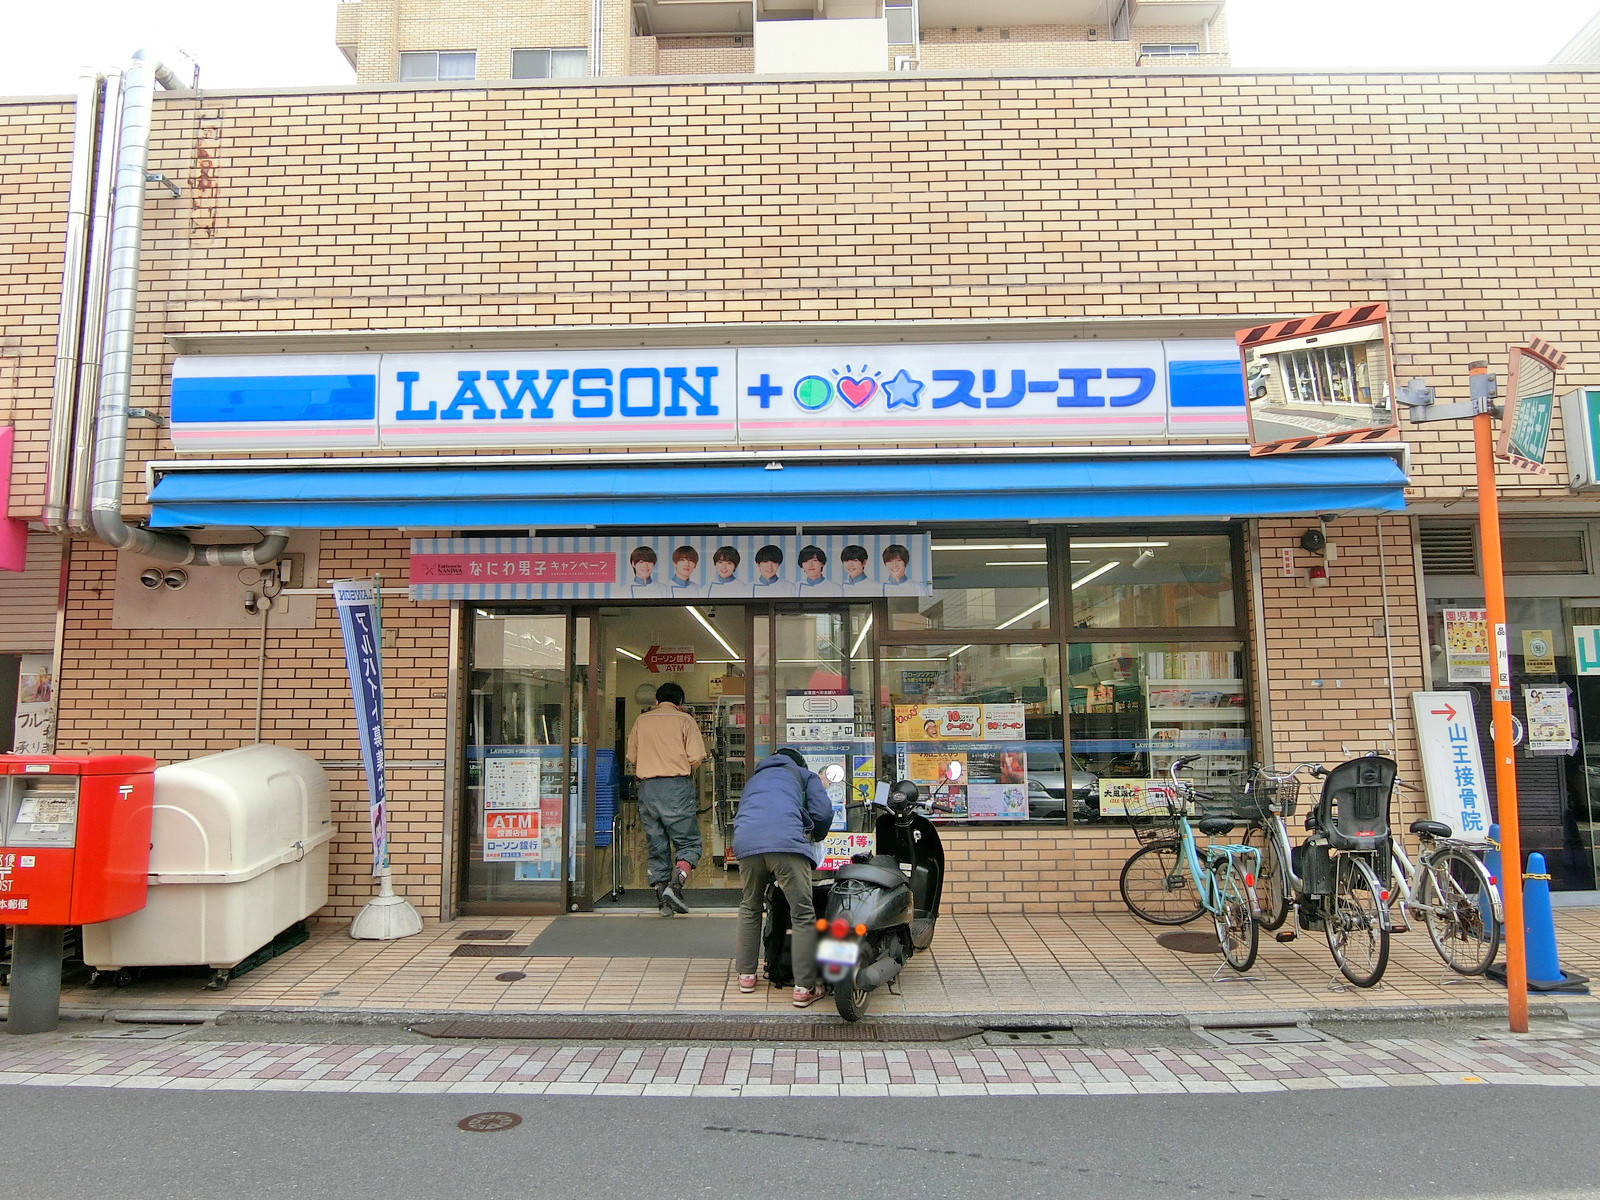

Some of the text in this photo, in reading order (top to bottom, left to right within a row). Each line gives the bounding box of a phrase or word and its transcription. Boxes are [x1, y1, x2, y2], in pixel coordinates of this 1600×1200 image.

[396, 366, 719, 420] LAWSON
[932, 368, 1156, 409] スリーエフ
[469, 560, 608, 576] なにわ男子 キャンペーン
[1497, 627, 1508, 682] 品川区
[1448, 723, 1483, 832] 山王接骨院
[493, 815, 532, 828] ATM
[487, 841, 538, 850] ローソン銀行
